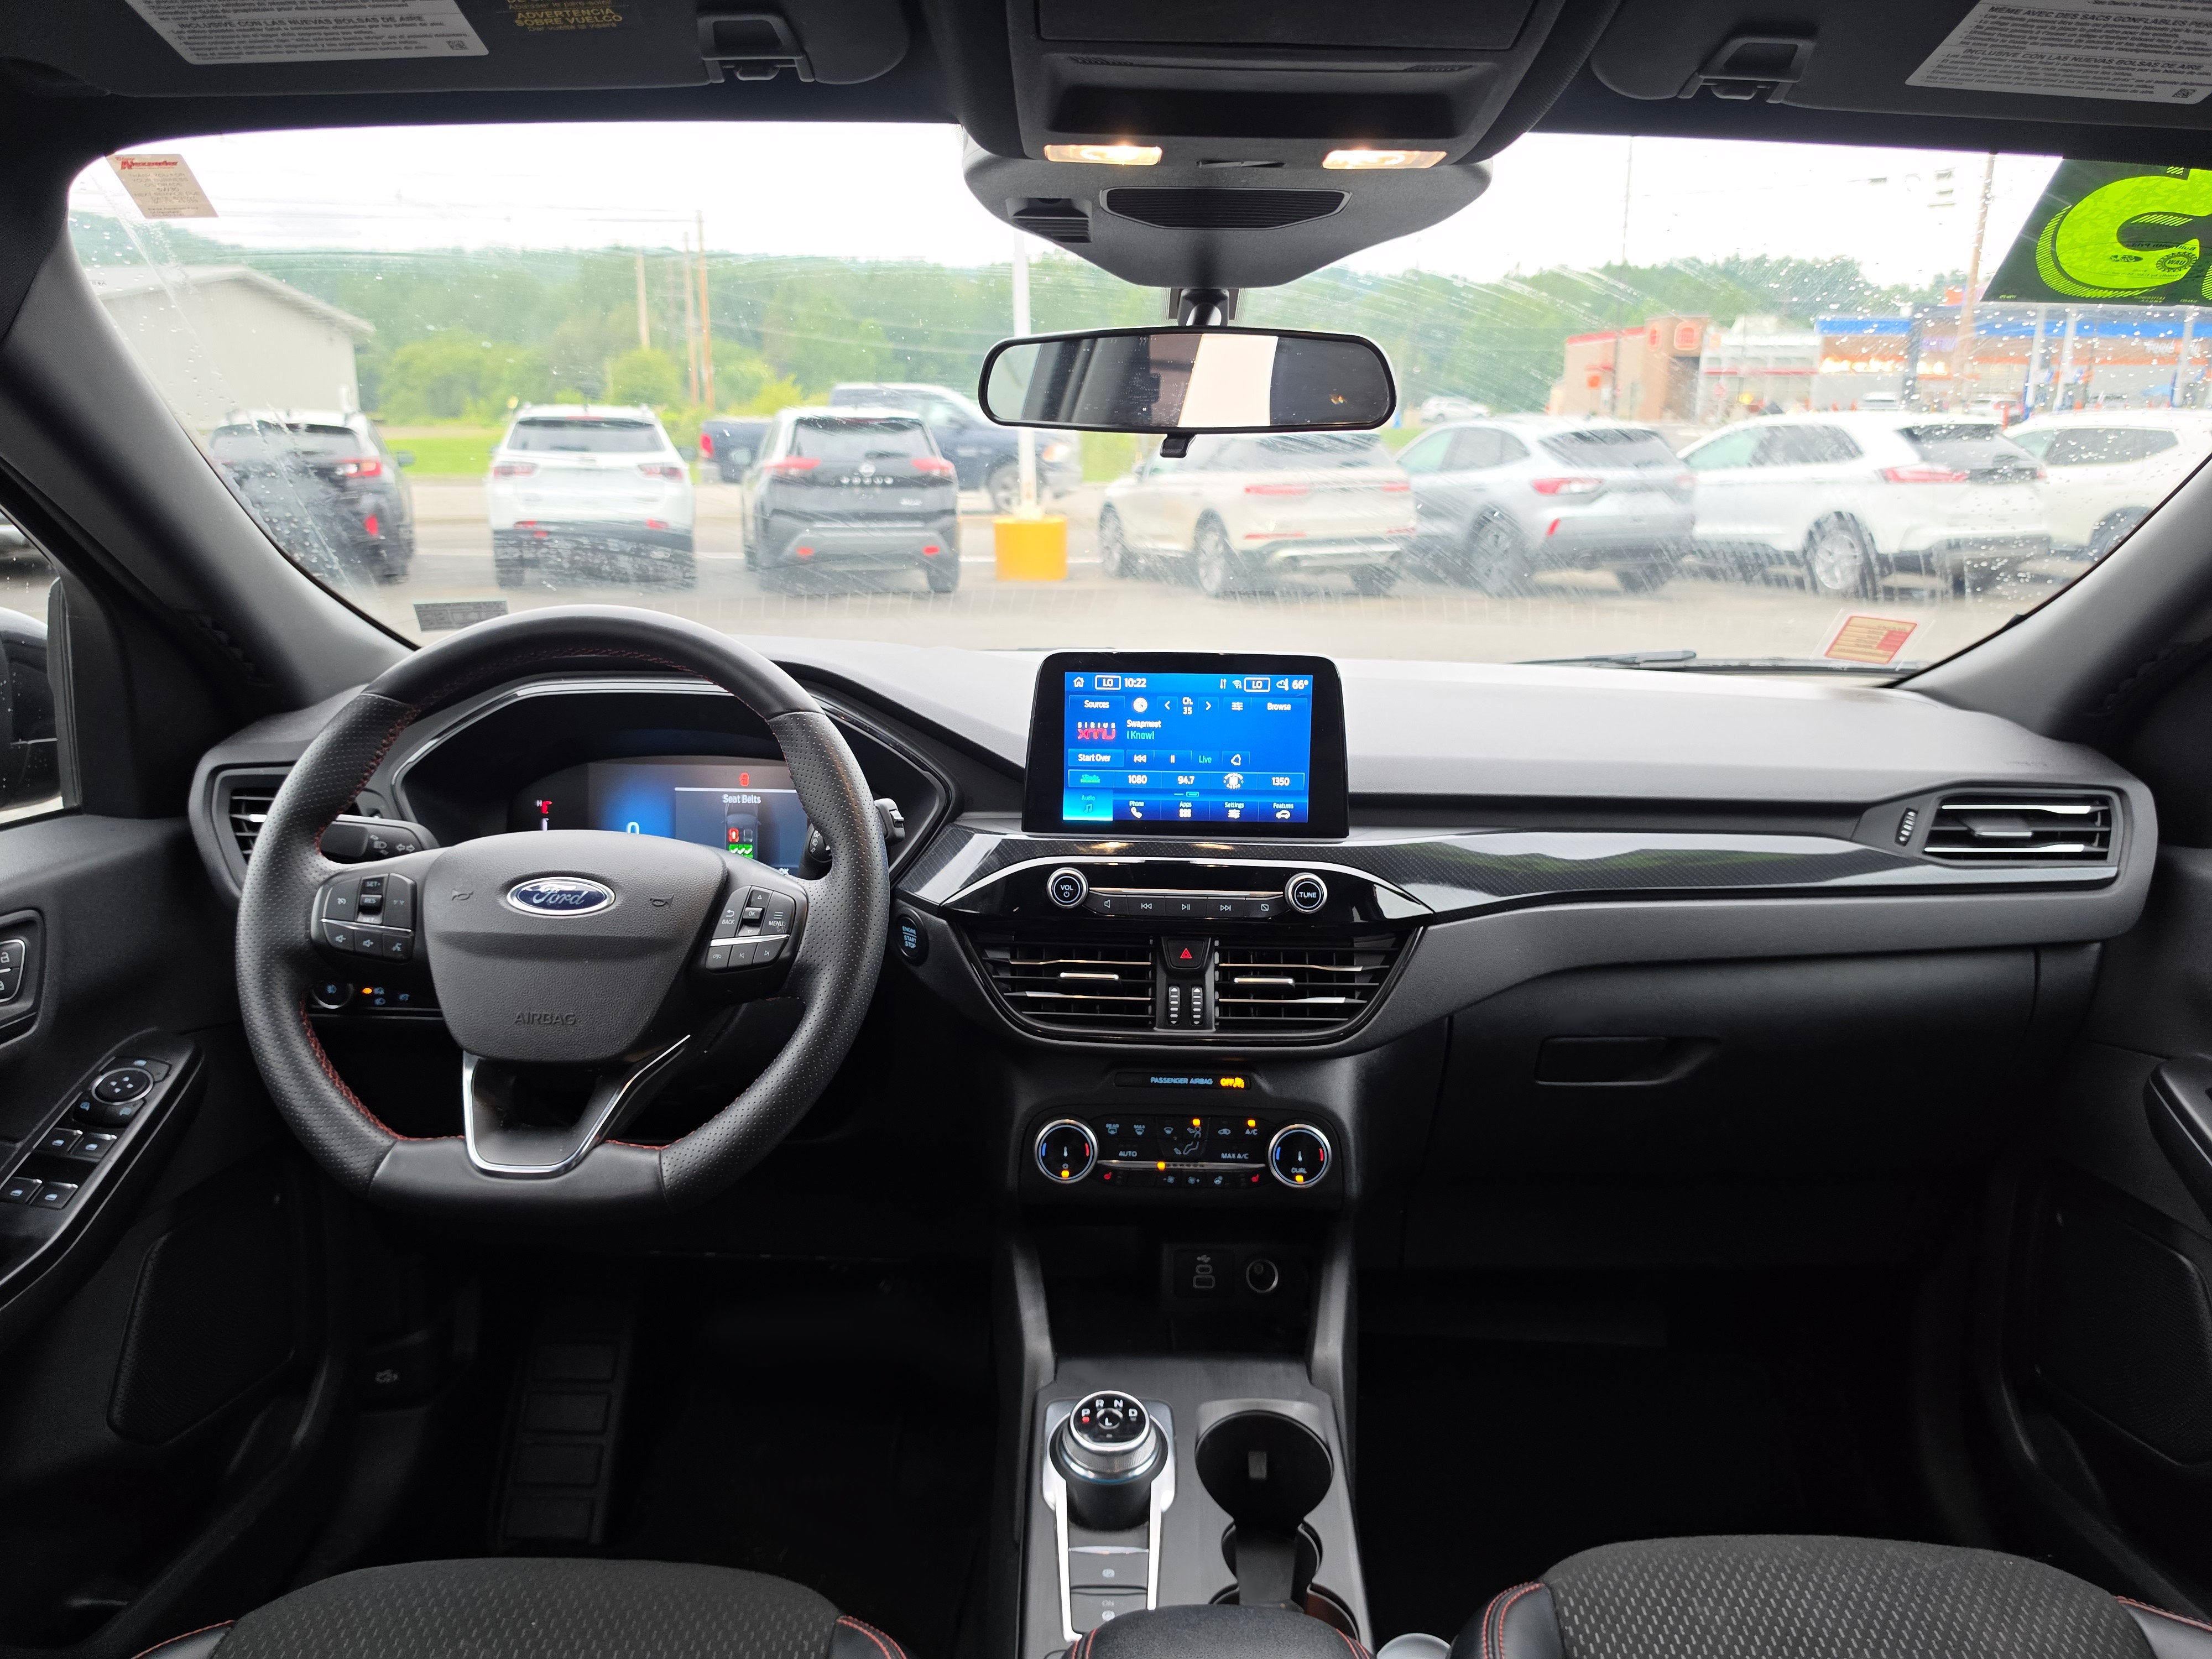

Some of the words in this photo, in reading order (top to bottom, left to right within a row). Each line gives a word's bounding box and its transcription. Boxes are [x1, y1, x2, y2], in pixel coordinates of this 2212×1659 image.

[518, 8, 615, 19] ADVERTENCIA
[2023, 9, 2054, 18] AVEC
[2080, 13, 2112, 22] SACS
[515, 18, 563, 27] SOBRE
[566, 14, 623, 24] VUELCO
[1963, 49, 2021, 58] INCLUSIVE
[2070, 56, 2114, 65] NUEVAS
[2115, 59, 2161, 67] BOLSAS
[1103, 678, 1114, 687] LO
[1124, 677, 1147, 687] 10:22
[1252, 680, 1262, 689] LO
[1084, 700, 1110, 708] Sources
[1267, 702, 1291, 711] Browse
[1183, 707, 1192, 715] 35
[1126, 719, 1162, 729] Swapmeet
[1126, 731, 1129, 739] I
[1078, 754, 1095, 762] Start
[1095, 754, 1112, 763] Over
[1128, 775, 1147, 784] 1080
[1177, 775, 1195, 785] 94.7
[1272, 777, 1290, 786] 1350
[722, 794, 740, 804] Seat
[742, 794, 761, 804] Belts
[533, 885, 589, 905] Ford
[904, 935, 916, 943] START
[515, 1012, 576, 1025] AIRBAG
[1220, 1078, 1234, 1086] OFF
[1095, 1399, 1104, 1407] R
[1114, 1399, 1123, 1407] N
[1082, 1408, 1090, 1417] P
[1105, 1417, 1113, 1426] L
